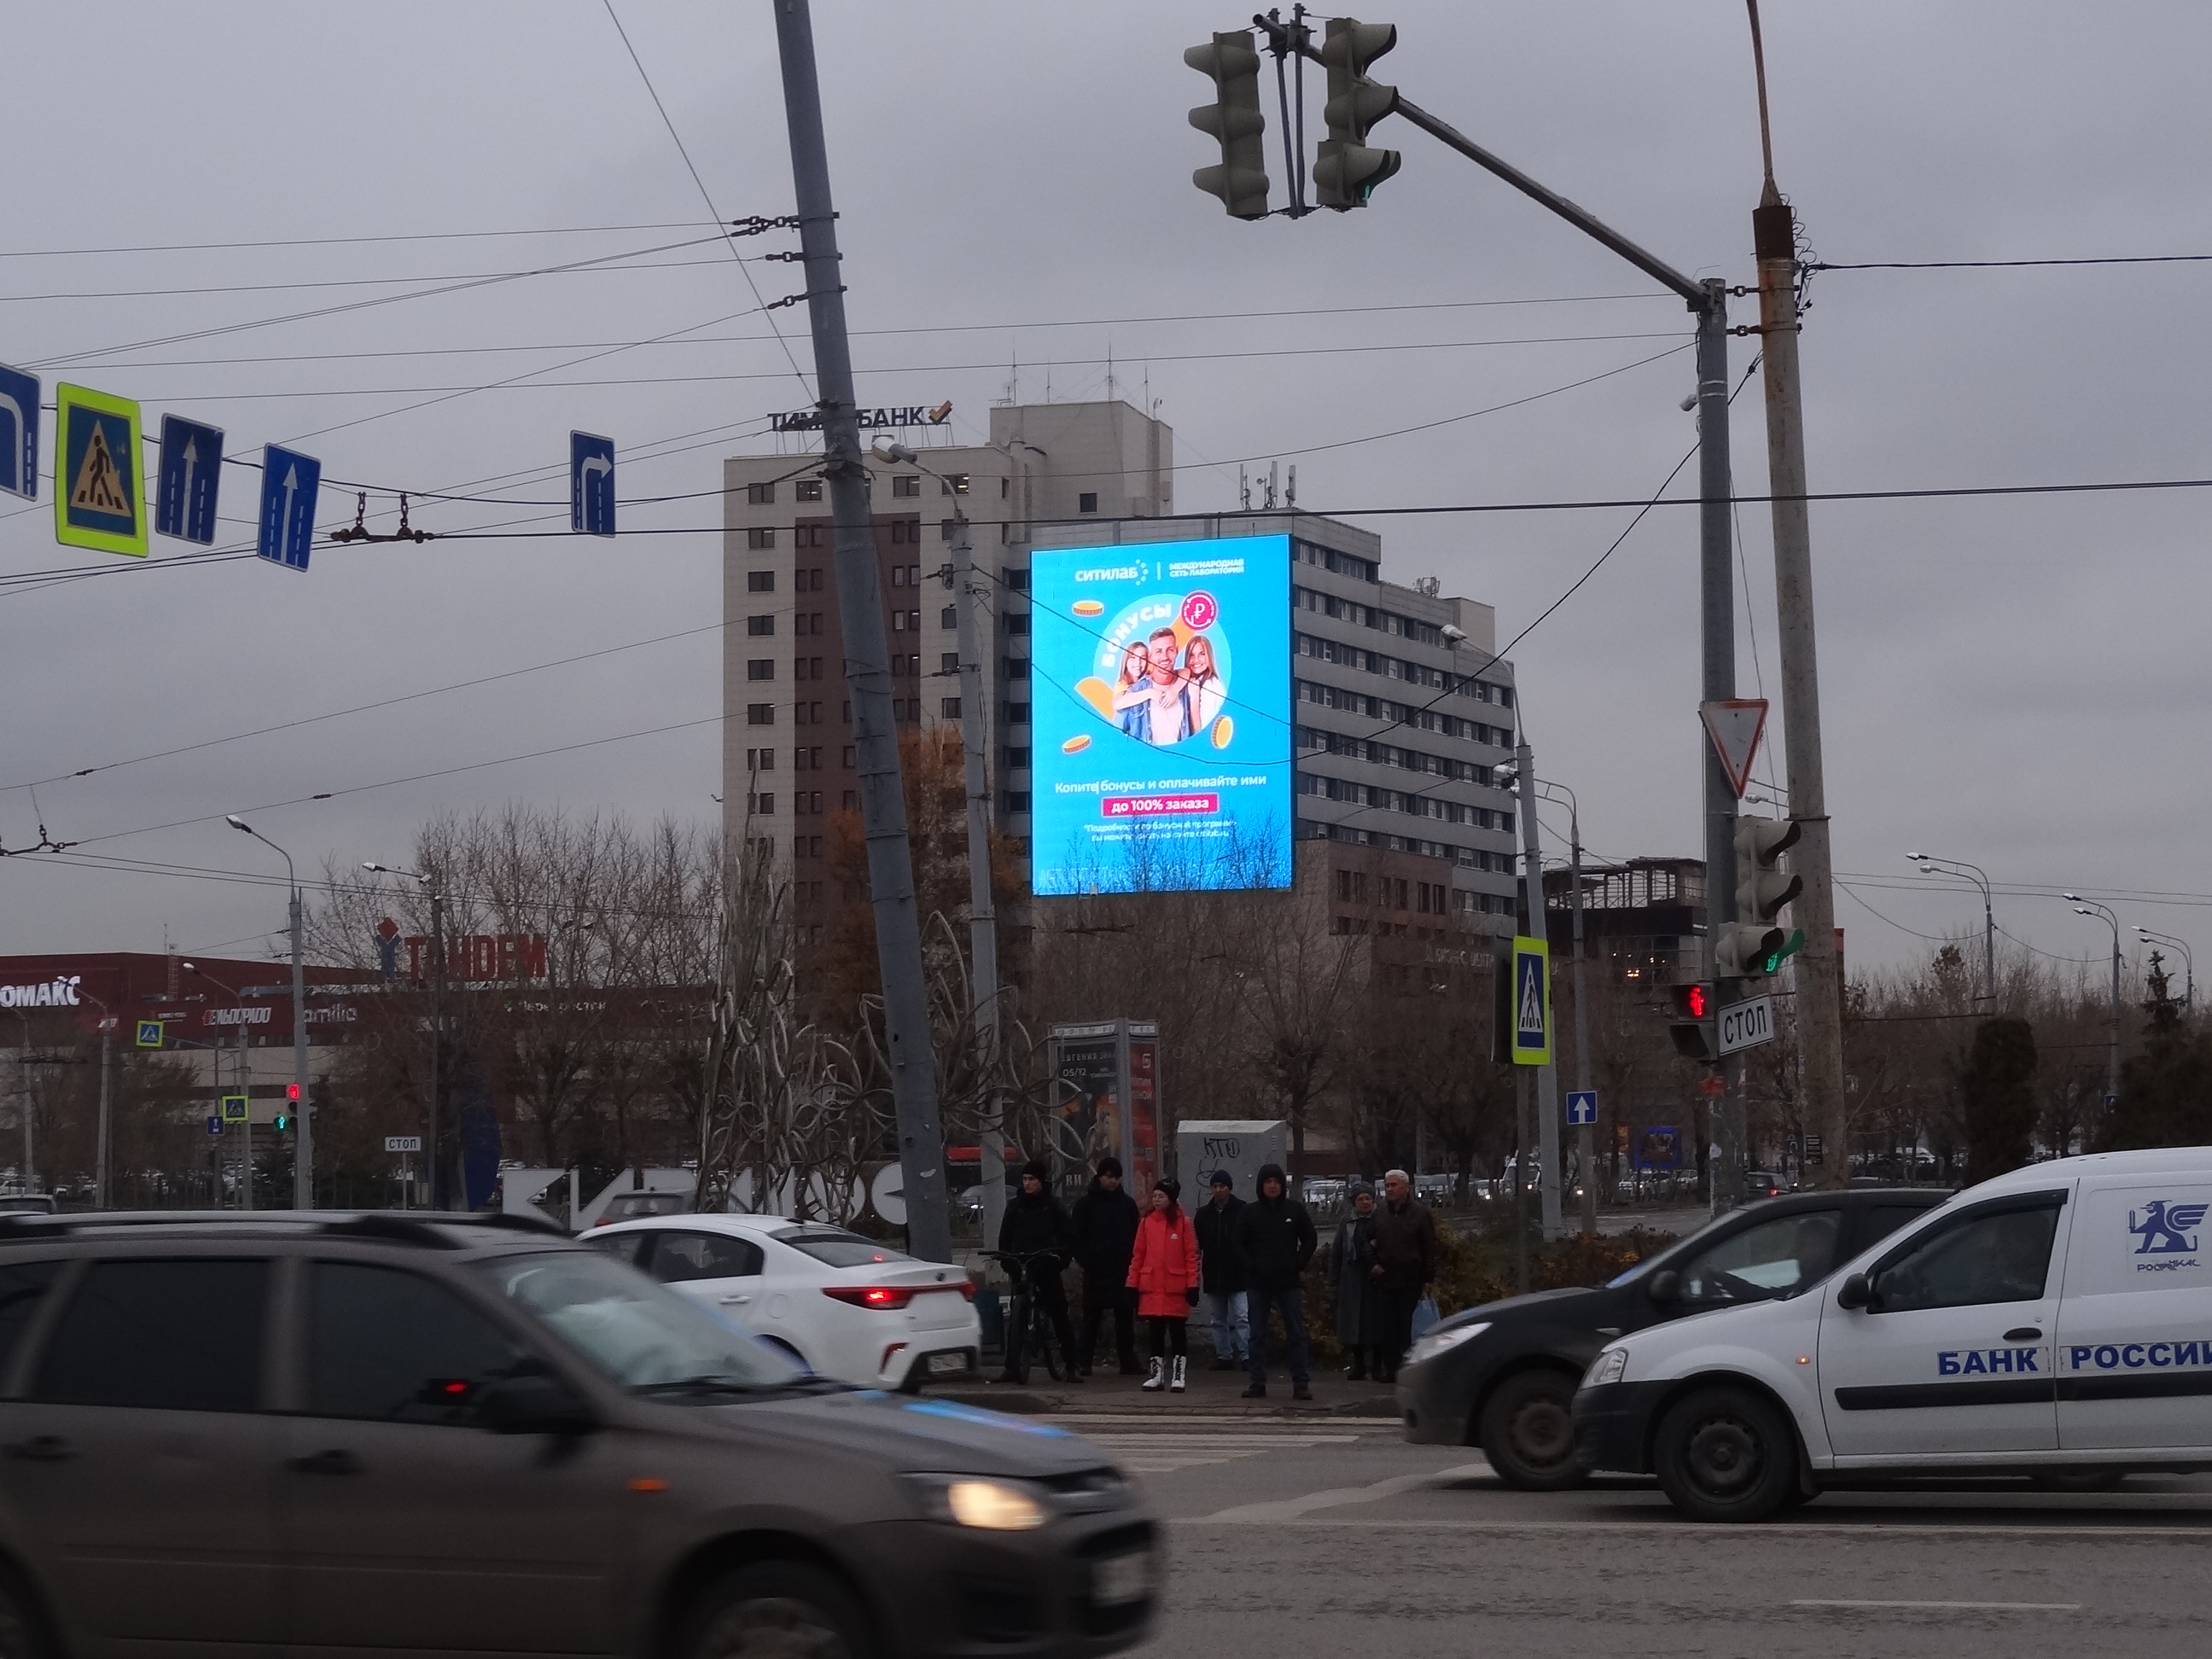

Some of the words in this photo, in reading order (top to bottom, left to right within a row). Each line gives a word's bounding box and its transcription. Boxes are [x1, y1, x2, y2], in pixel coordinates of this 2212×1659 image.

[1189, 566, 1244, 576] ЛАБОРАТОРИЙ
[1100, 779, 1145, 793] бонусы
[1148, 780, 1156, 789] и
[1158, 776, 1238, 789] оплачивайте
[1240, 775, 1267, 786] ими
[1111, 802, 1129, 814] до
[1130, 799, 1164, 812] 100%
[1165, 799, 1209, 810] заказа
[1724, 1004, 1767, 1045] СТОП
[388, 1138, 417, 1150] СТОП
[1938, 1349, 2039, 1376] БАНК
[2070, 1342, 2212, 1370] РОССИИ
